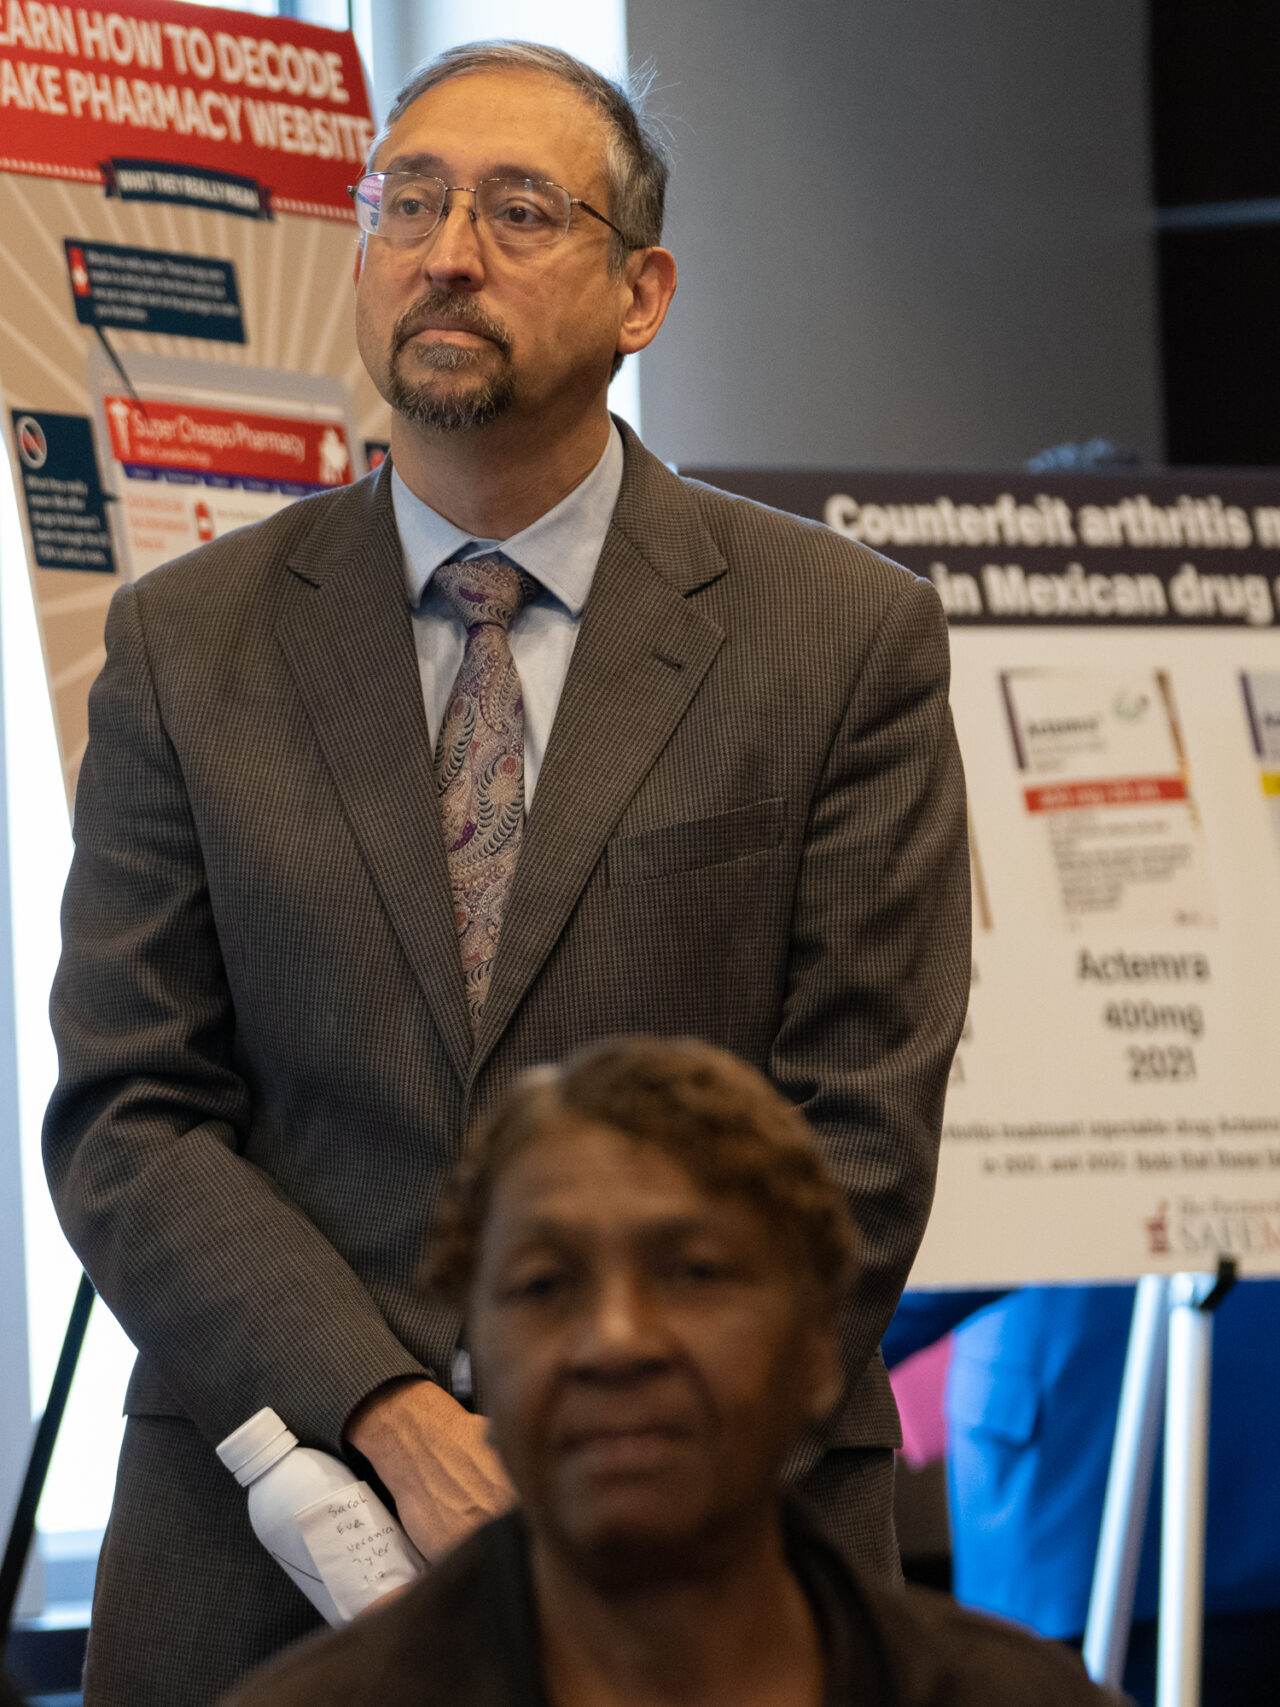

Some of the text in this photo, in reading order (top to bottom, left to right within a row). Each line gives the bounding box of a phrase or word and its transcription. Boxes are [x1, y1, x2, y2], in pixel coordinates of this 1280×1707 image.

[81, 10, 163, 71] HOW
[165, 22, 216, 80] TO
[217, 31, 351, 103] DECODE
[68, 68, 243, 144] PHARMACY
[132, 408, 177, 441] Super
[826, 493, 1076, 547] Counterfeit
[1078, 493, 1252, 550] arthritis
[930, 561, 983, 617] in
[983, 560, 1168, 618] Mexican
[1169, 560, 1274, 628] drug
[1077, 947, 1211, 983] Actemra
[1104, 1002, 1206, 1040] 400mg
[1128, 1046, 1197, 1082] 2021
